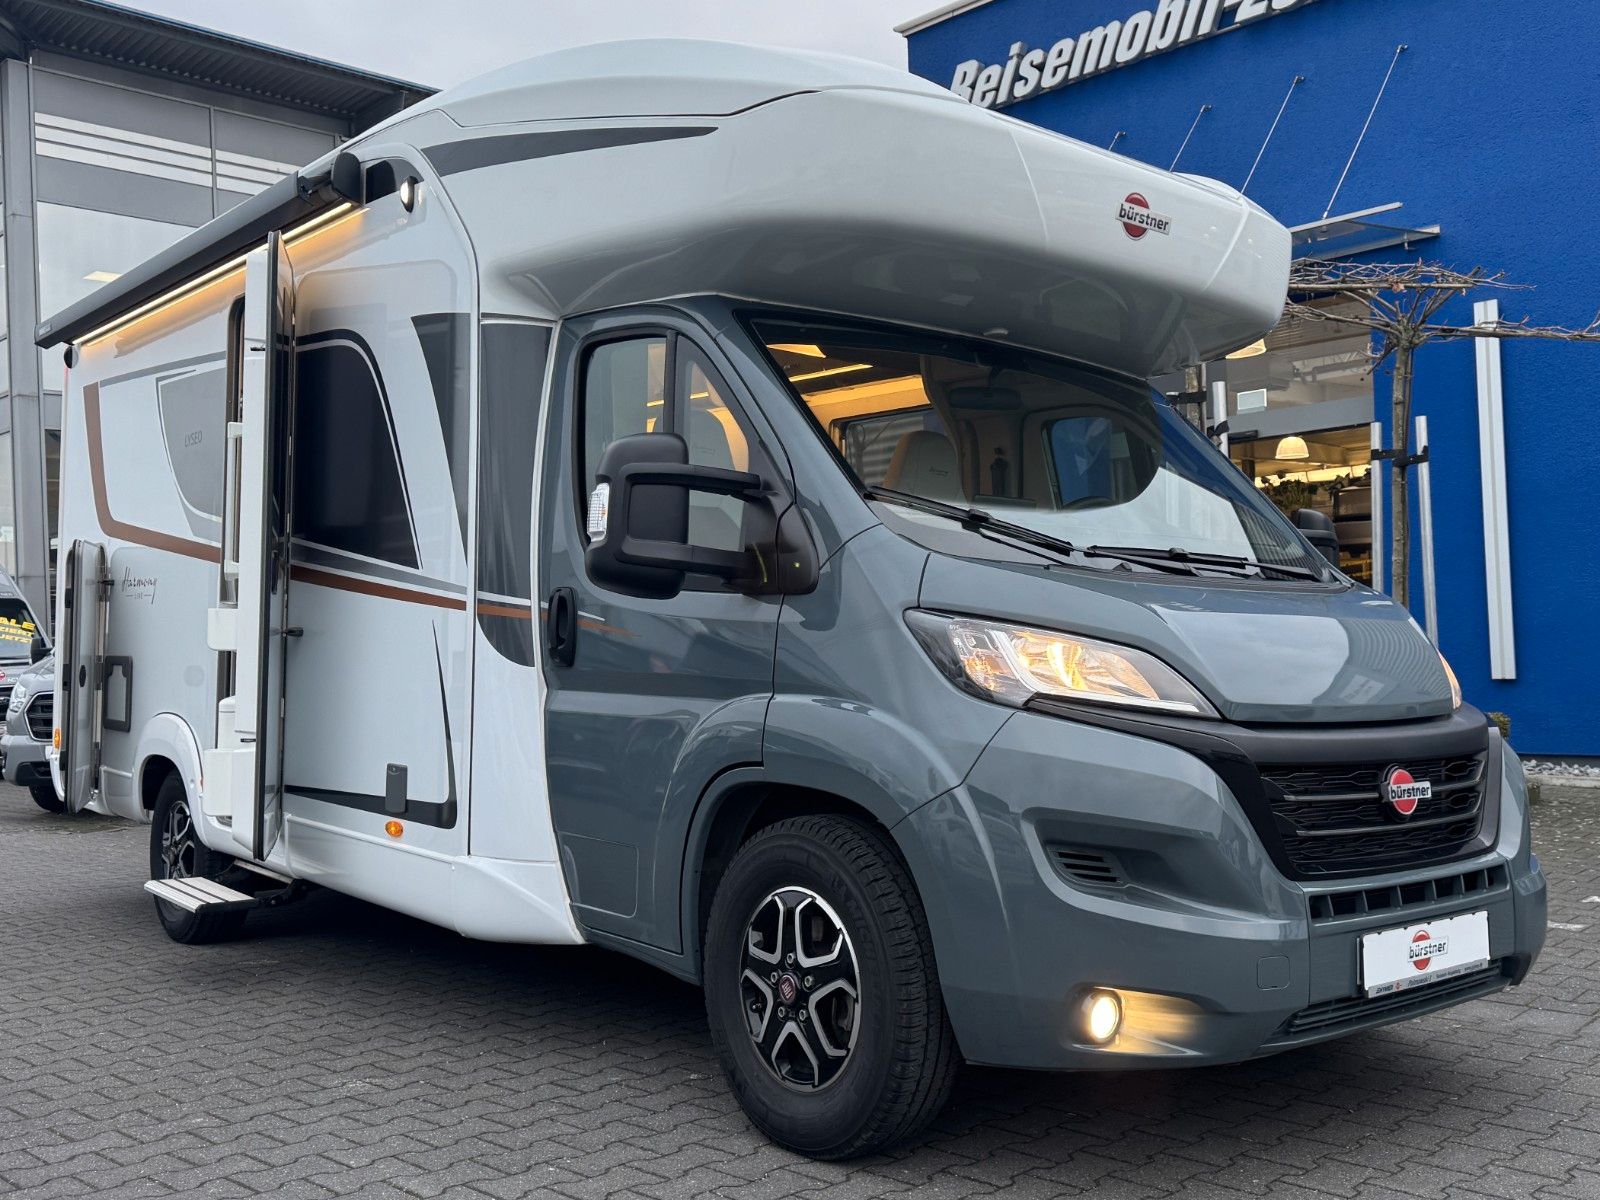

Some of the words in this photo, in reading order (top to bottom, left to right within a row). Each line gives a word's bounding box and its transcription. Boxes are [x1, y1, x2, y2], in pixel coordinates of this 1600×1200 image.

[1119, 203, 1169, 231] bürstner
[1390, 785, 1430, 799] bürstner
[1409, 942, 1447, 959] bürstner
